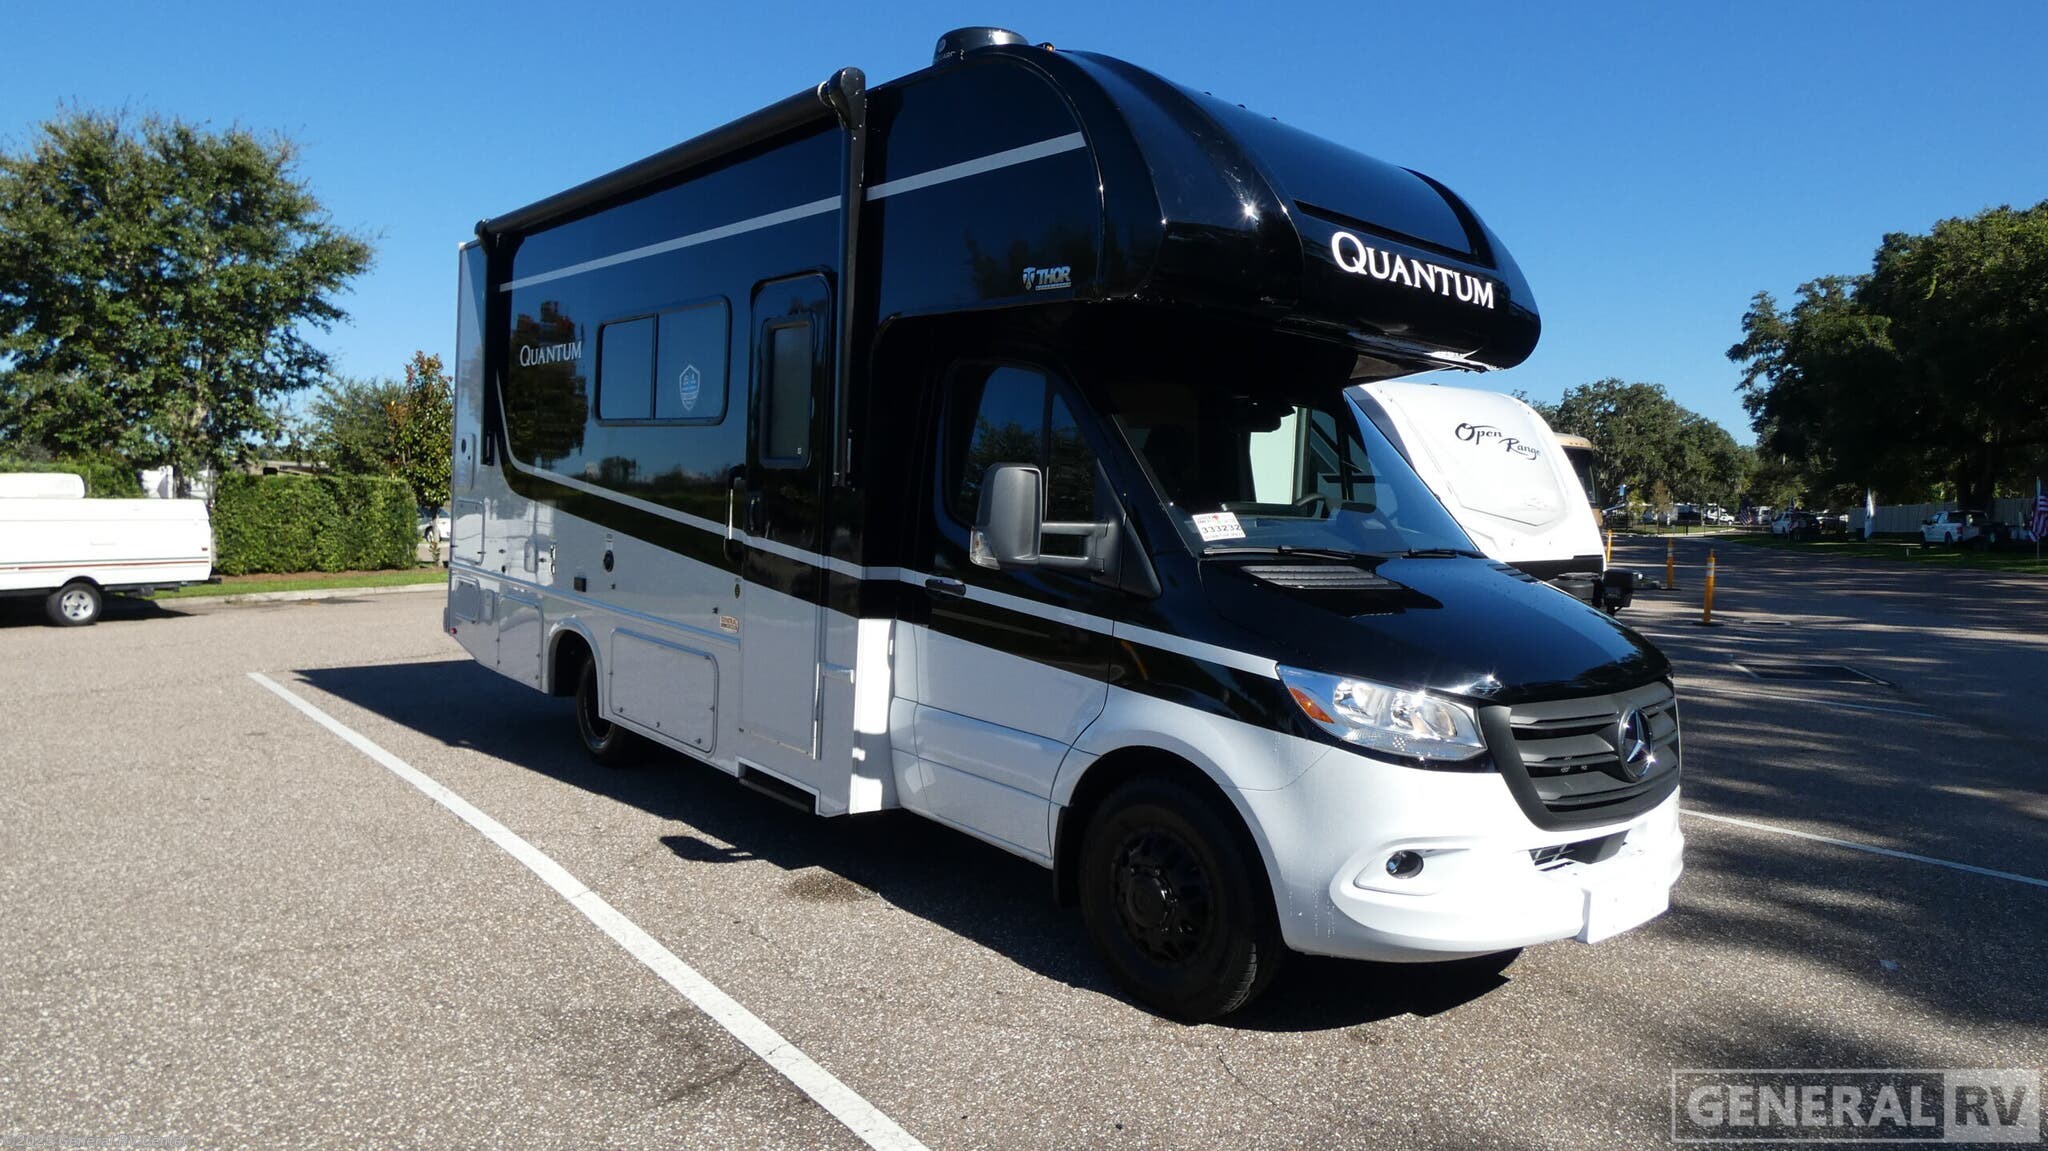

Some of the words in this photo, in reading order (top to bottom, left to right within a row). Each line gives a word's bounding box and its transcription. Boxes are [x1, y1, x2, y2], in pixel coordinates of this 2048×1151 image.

[1036, 265, 1071, 285] THOR
[1331, 231, 1493, 308] QUANTUM
[519, 340, 582, 367] QUANTUM
[1455, 422, 1503, 446] Open
[1498, 437, 1541, 461] Range
